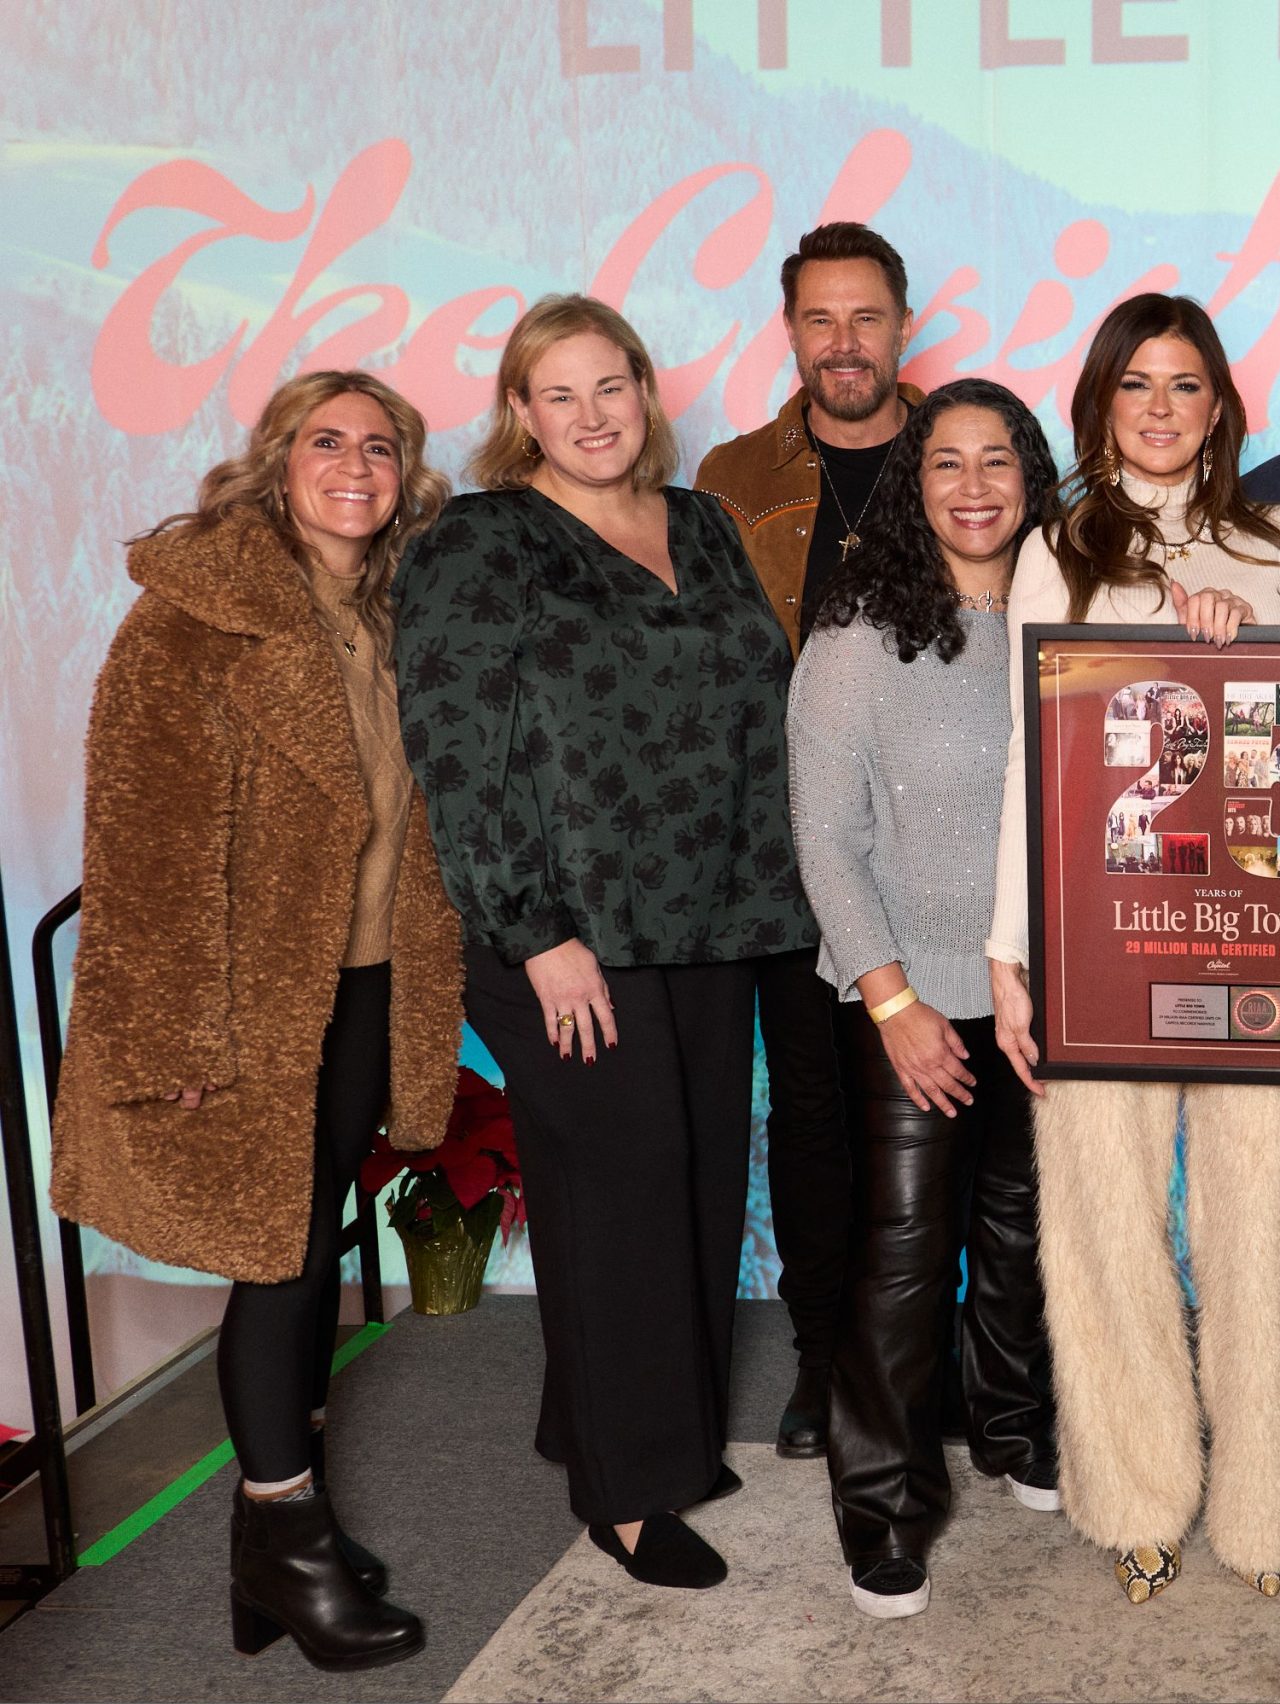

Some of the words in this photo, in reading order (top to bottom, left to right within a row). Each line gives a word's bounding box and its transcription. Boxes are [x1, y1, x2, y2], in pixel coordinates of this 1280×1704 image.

[91, 137, 526, 433] The
[1194, 888, 1226, 897] YEARS
[1229, 889, 1243, 897] OF
[1113, 900, 1187, 932] Little
[1194, 902, 1240, 942] Big
[1126, 941, 1141, 954] 29
[1144, 941, 1188, 955] MILLION
[1191, 942, 1217, 956] RIAA
[1221, 943, 1276, 957] CERTIFIED
